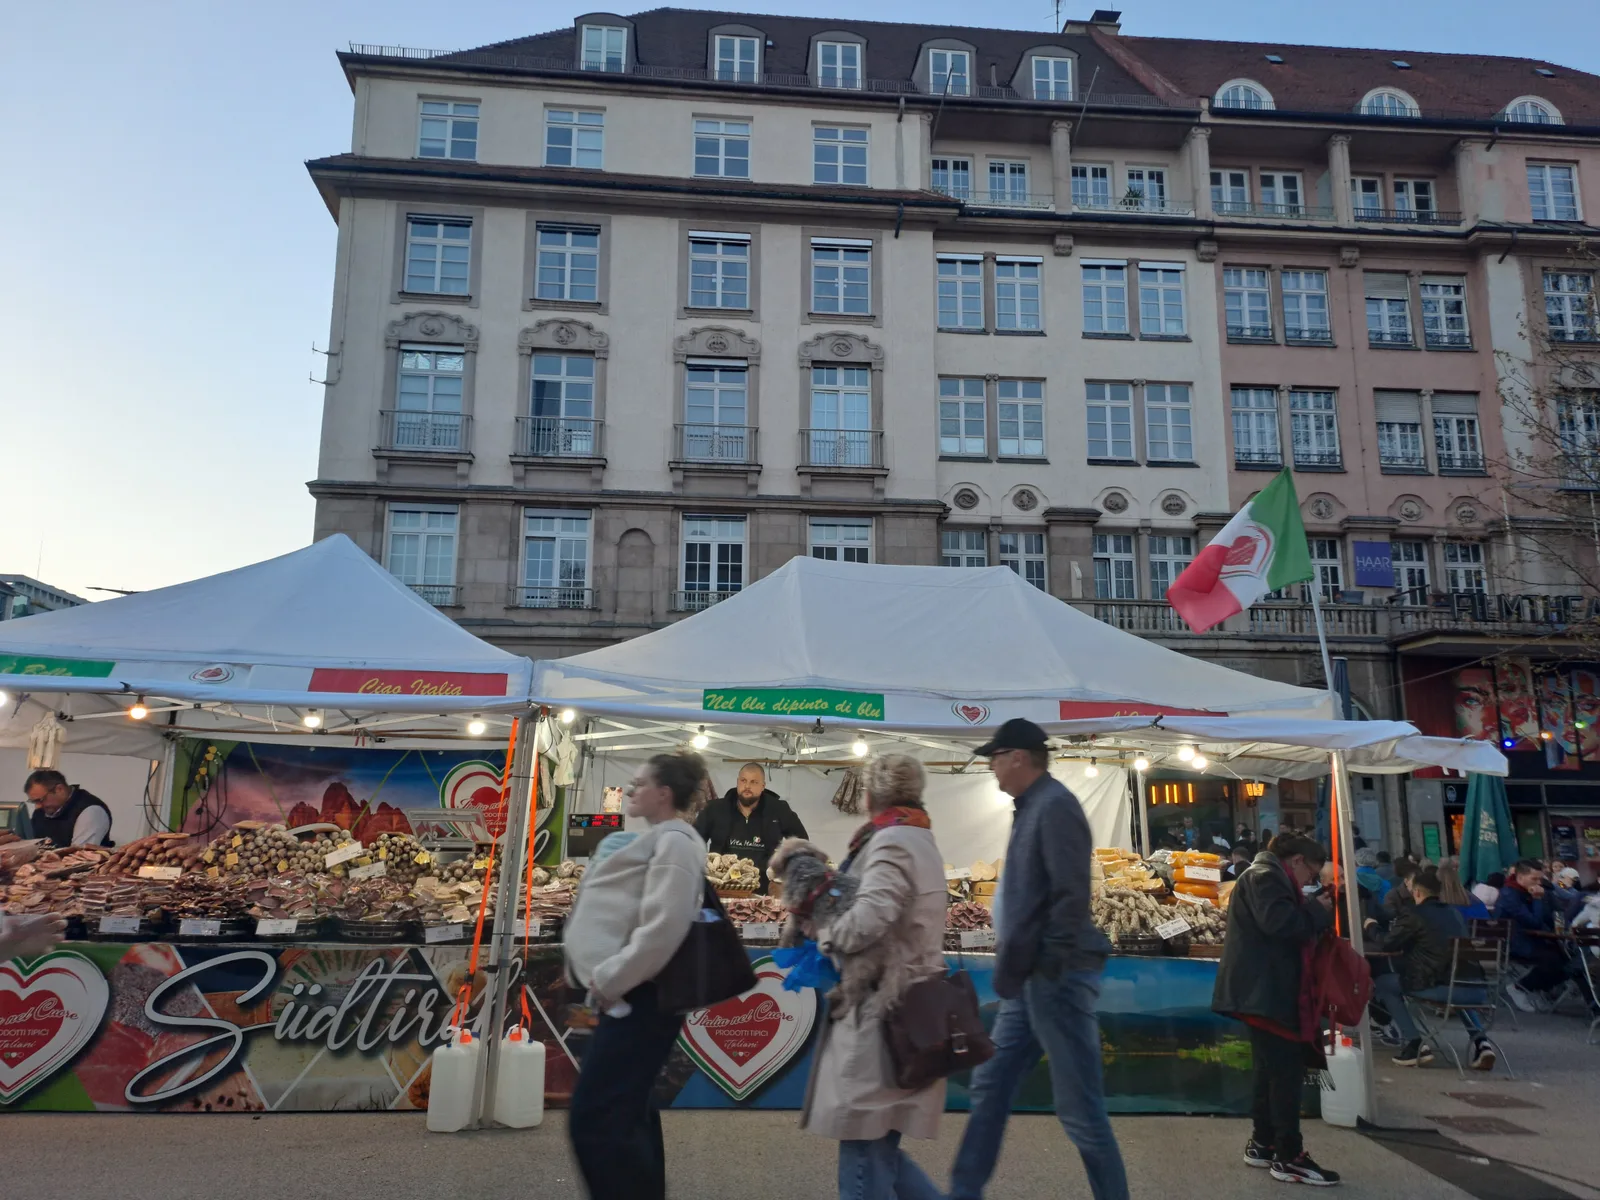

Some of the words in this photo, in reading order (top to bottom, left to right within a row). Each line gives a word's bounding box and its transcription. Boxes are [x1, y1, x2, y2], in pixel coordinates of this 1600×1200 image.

[1356, 556, 1390, 568] HAAR
[357, 678, 402, 694] Ciao
[410, 679, 463, 696] Italia
[705, 694, 737, 710] Nel
[741, 696, 766, 710] blu
[772, 697, 829, 715] dipinto
[835, 700, 852, 713] di
[857, 701, 880, 717] blu
[34, 997, 79, 1021] Cuore
[689, 1008, 729, 1028] Italia
[730, 1009, 753, 1025] nel
[754, 1000, 794, 1022] Cuore
[715, 1029, 749, 1037] PRODOTTI
